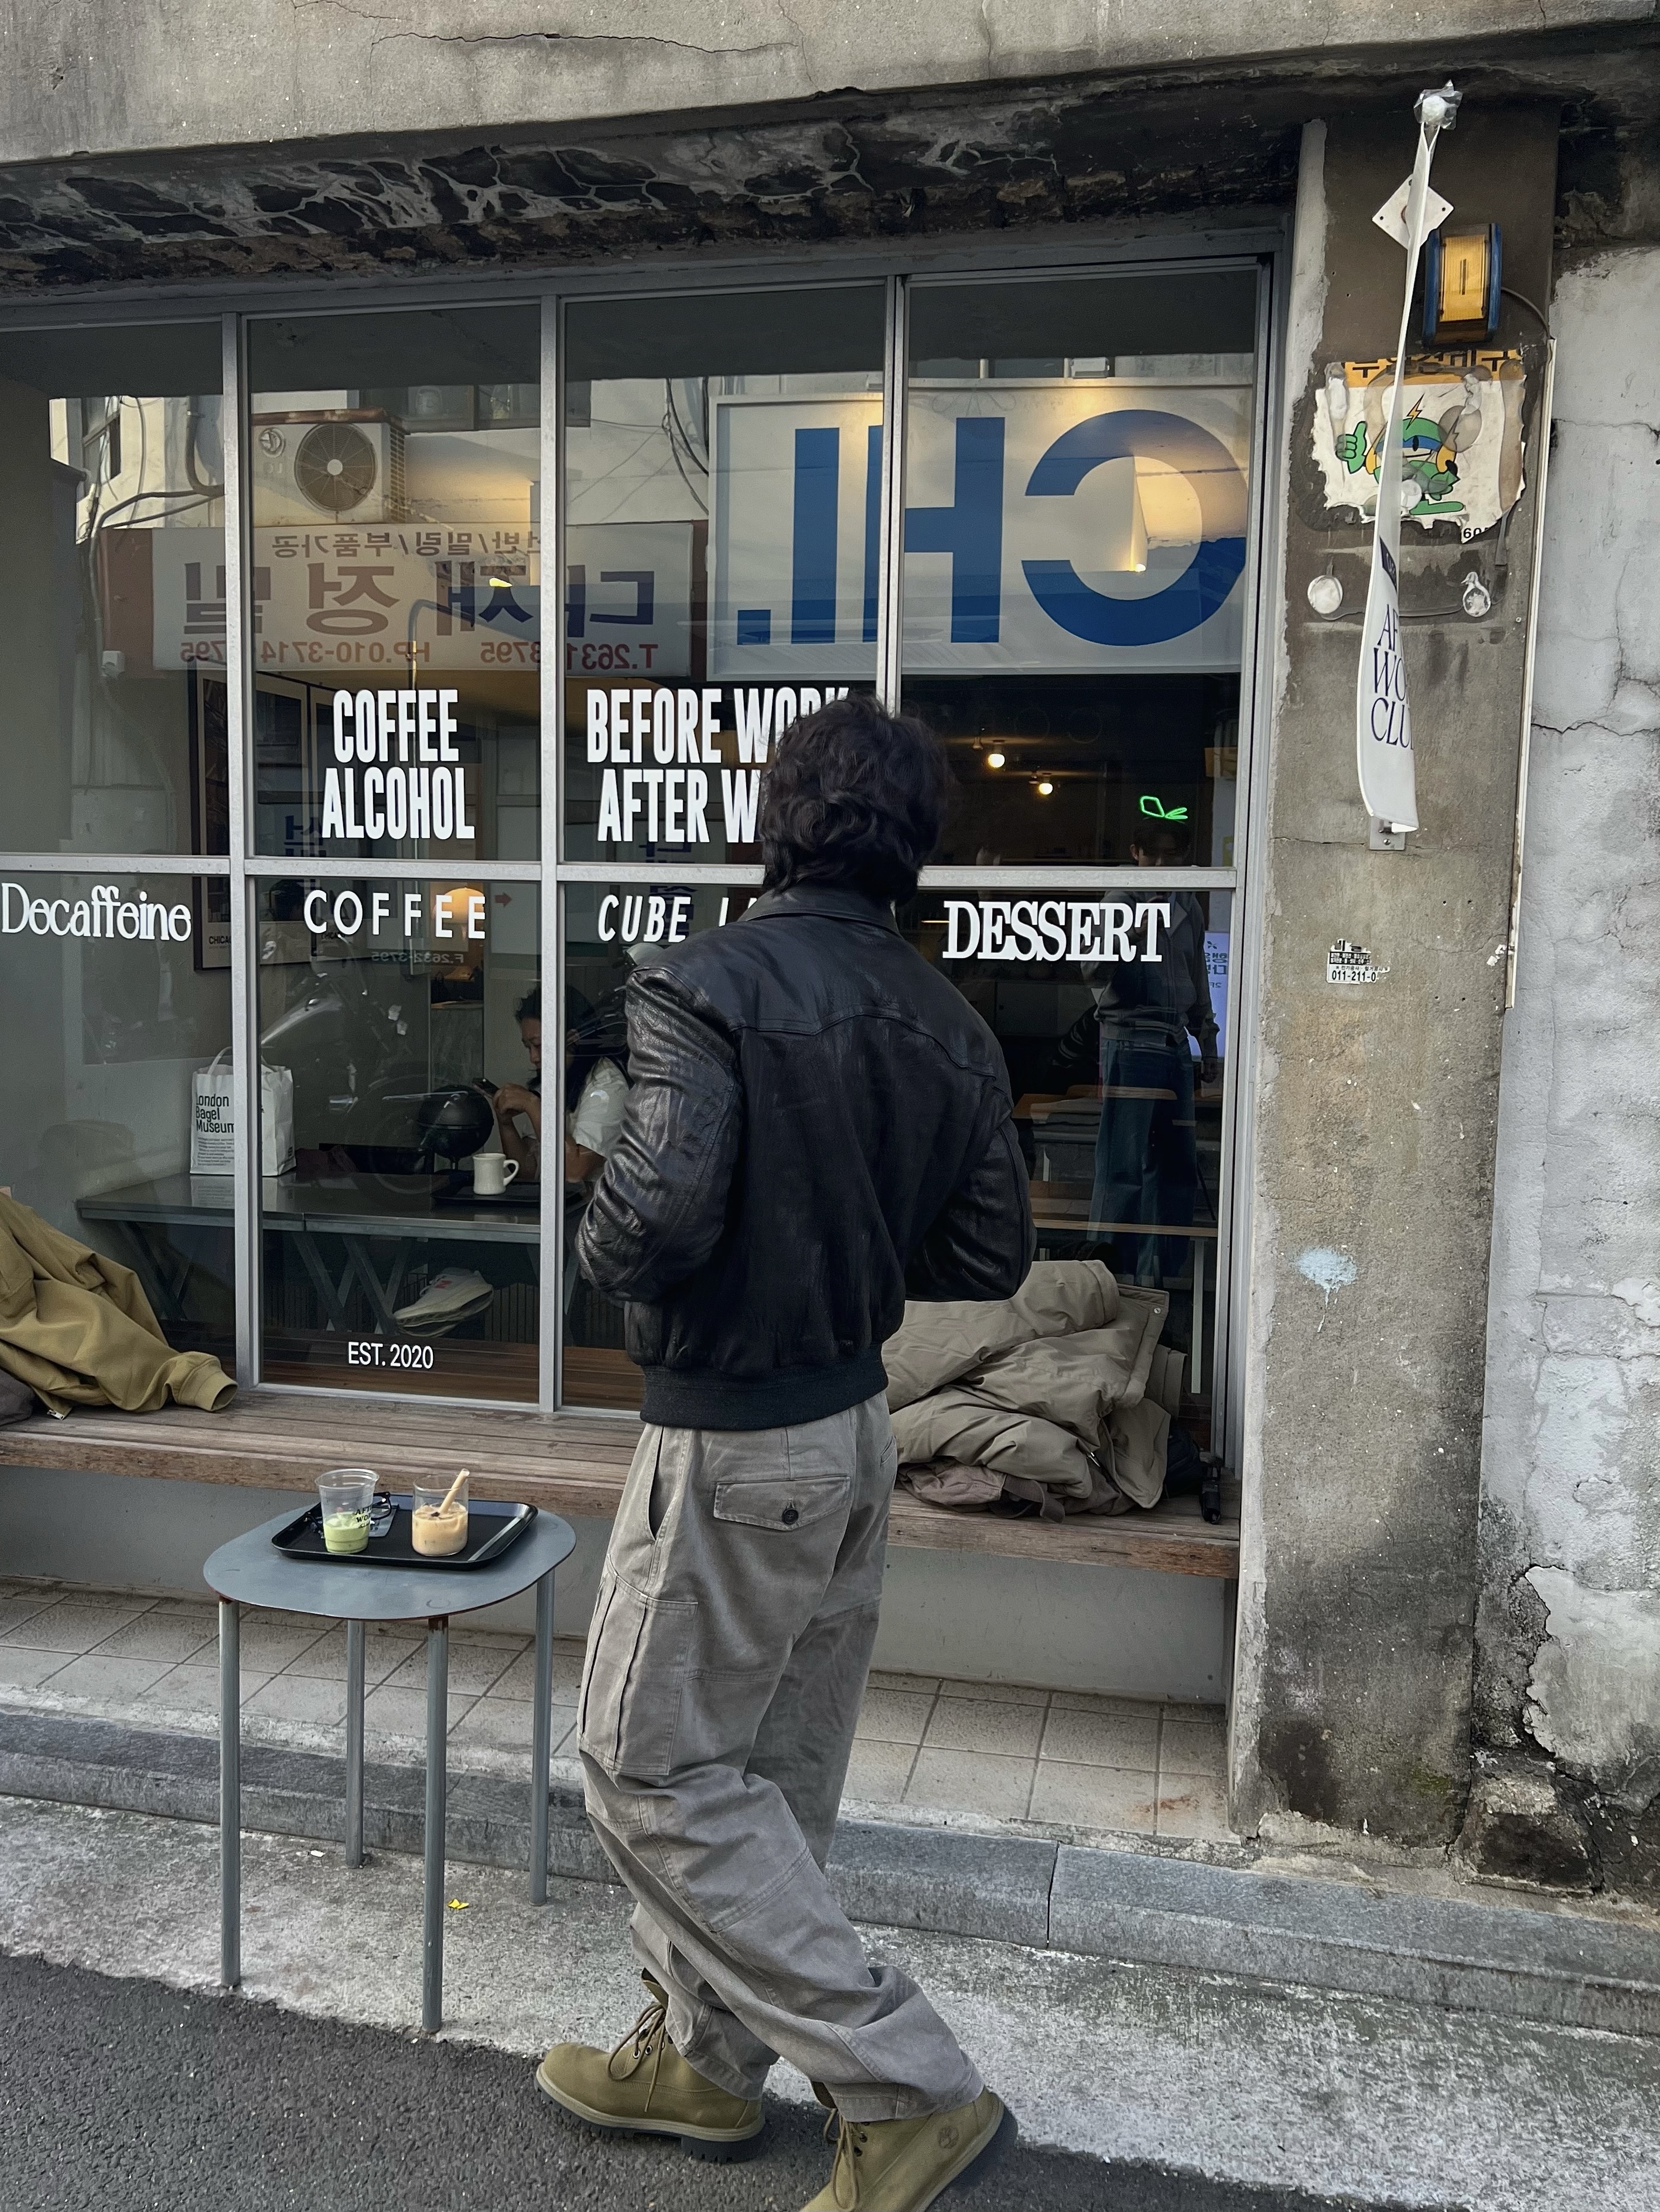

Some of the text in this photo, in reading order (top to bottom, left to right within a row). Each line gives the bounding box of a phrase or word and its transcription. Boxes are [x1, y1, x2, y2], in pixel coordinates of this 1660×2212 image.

[1463, 527, 1490, 538] 60
[333, 689, 459, 763] COFFEE
[587, 687, 849, 764] BEFORE WO
[1371, 697, 1414, 749] CLU
[322, 766, 475, 840] ALCOHOL
[597, 769, 710, 843] AFTER
[1, 883, 192, 941] Decaffeine
[303, 890, 486, 939] COFFEE
[597, 894, 692, 942] CUBE
[942, 900, 1171, 962] DESSERT
[196, 1093, 230, 1107] London
[196, 1106, 220, 1123] Bagel
